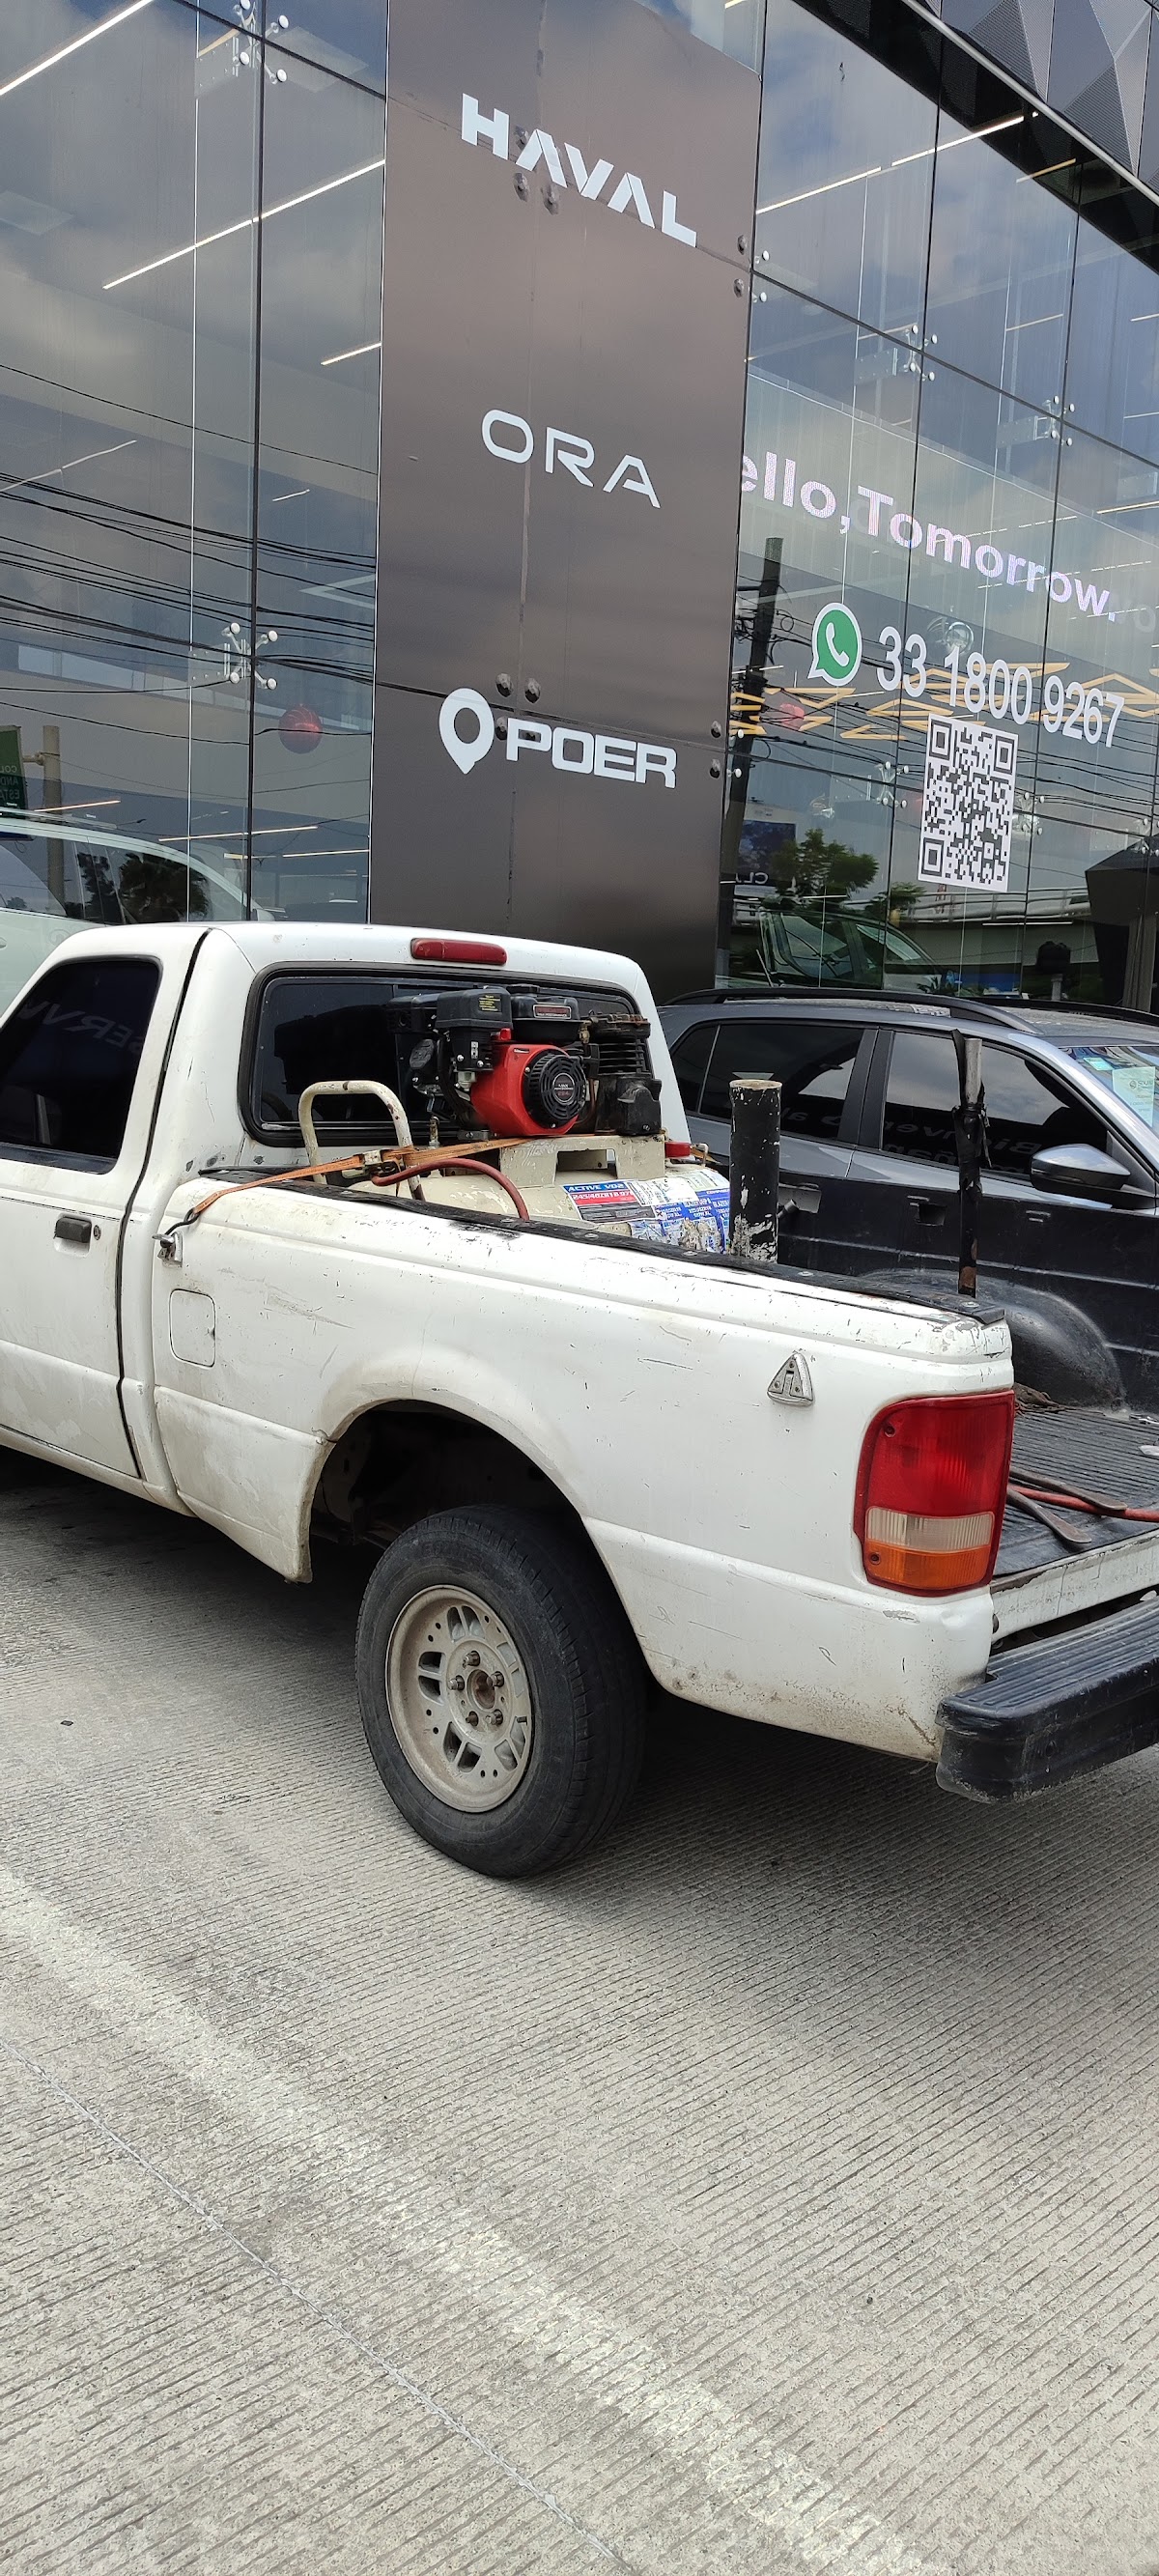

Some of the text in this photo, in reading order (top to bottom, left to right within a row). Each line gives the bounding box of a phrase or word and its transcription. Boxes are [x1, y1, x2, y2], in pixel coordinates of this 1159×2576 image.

[461, 93, 697, 248] HAVAL
[481, 409, 662, 509] ORA
[876, 626, 1126, 749] 33 1800 9267
[505, 718, 677, 789] POER
